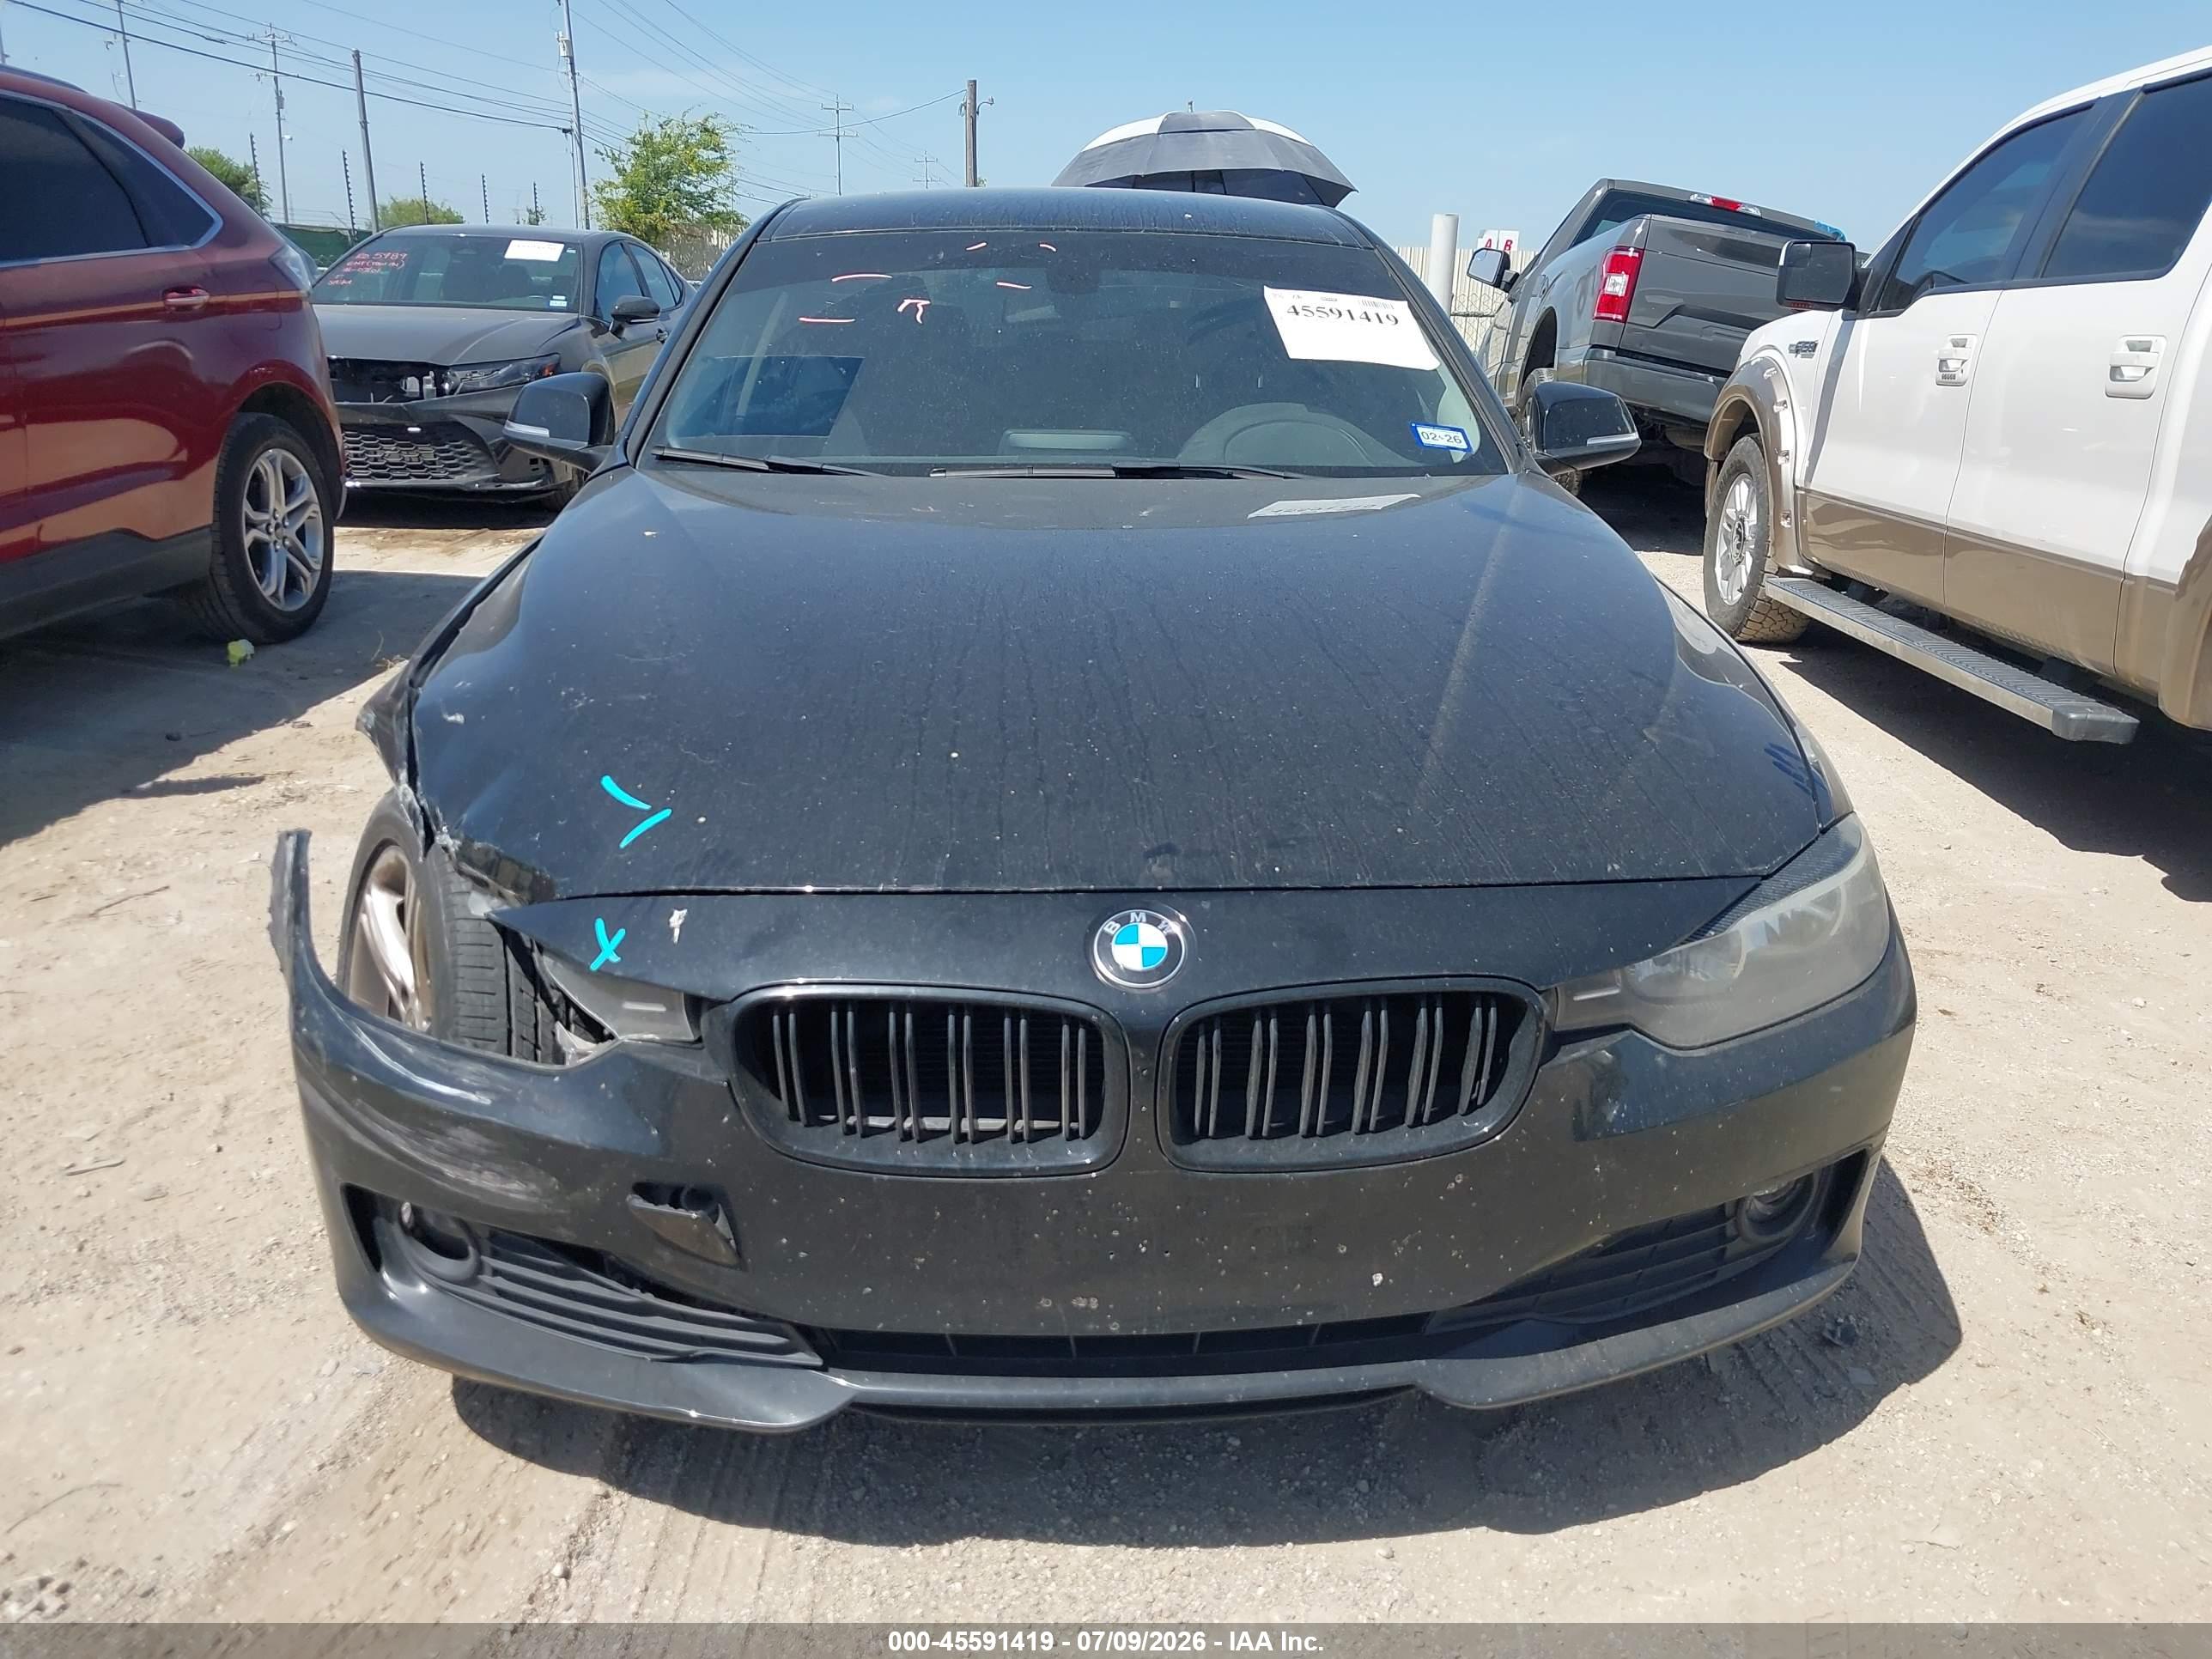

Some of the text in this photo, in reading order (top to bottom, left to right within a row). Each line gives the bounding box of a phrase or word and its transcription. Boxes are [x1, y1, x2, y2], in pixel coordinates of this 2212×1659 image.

[1485, 238, 1492, 248] A
[1286, 305, 1400, 325] 45591419
[1103, 911, 1174, 936] BMW
